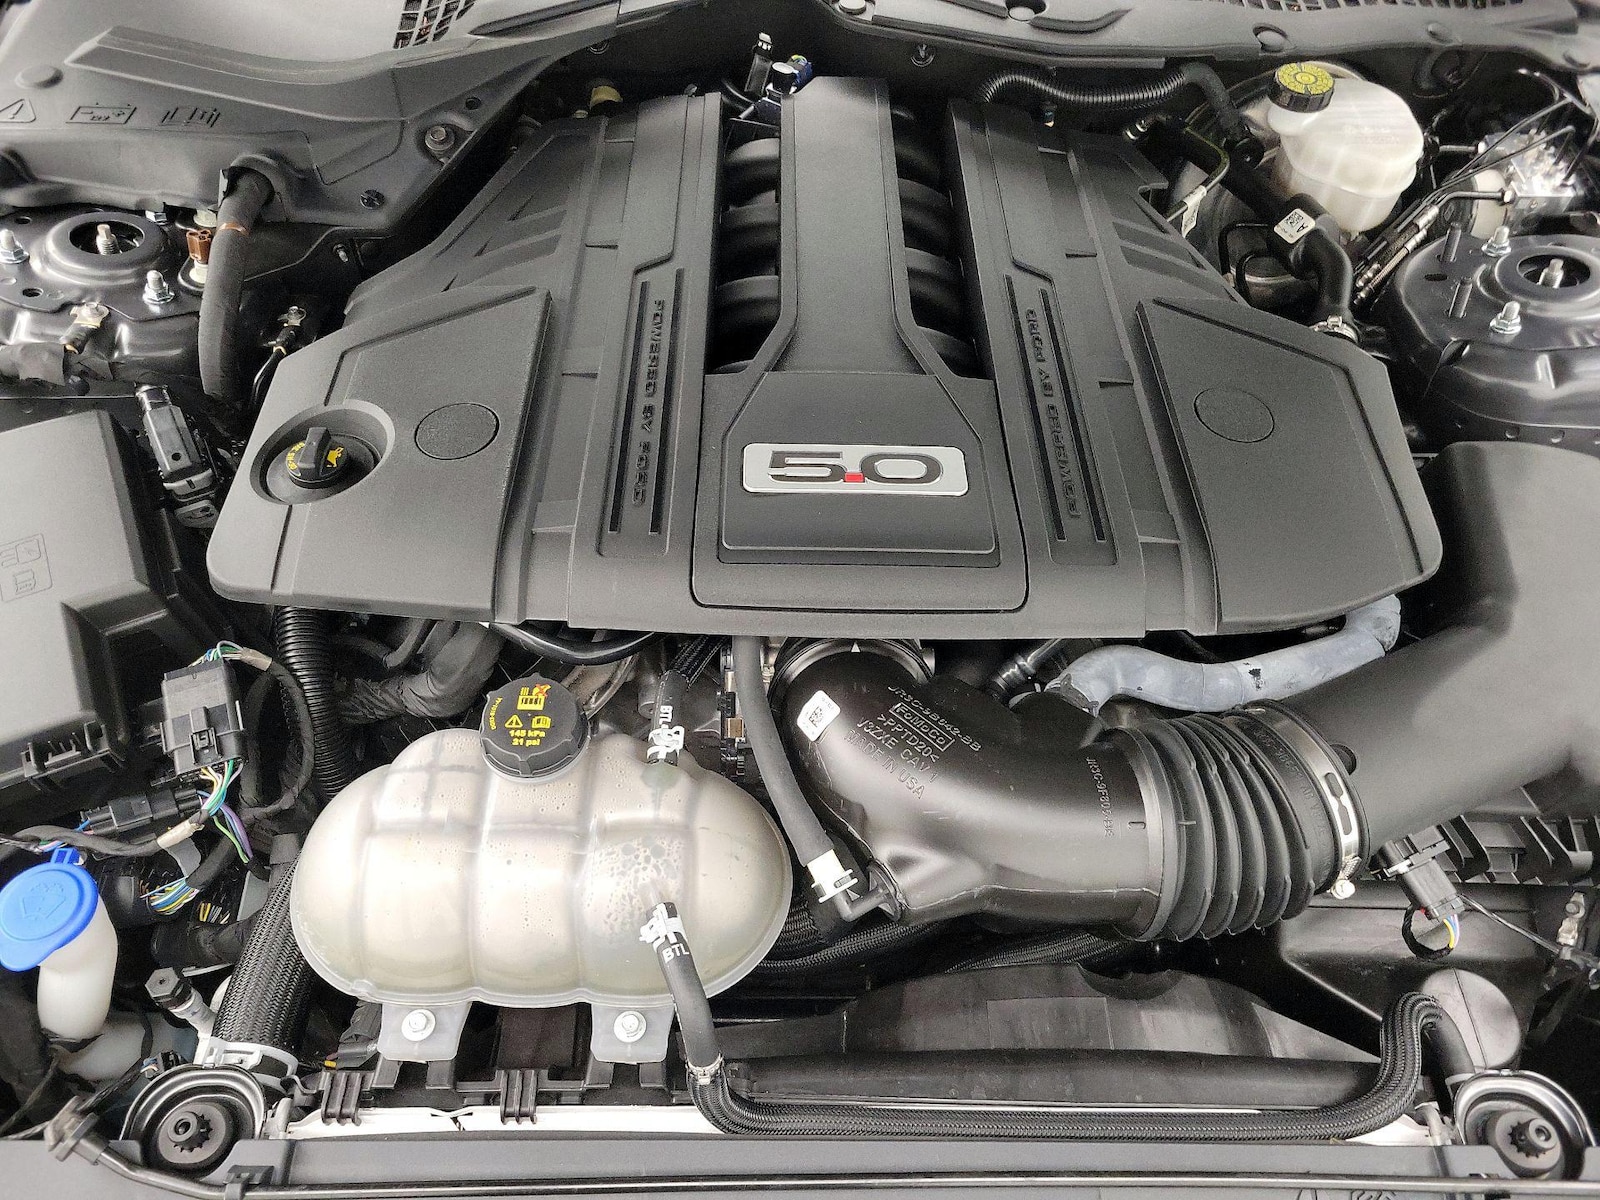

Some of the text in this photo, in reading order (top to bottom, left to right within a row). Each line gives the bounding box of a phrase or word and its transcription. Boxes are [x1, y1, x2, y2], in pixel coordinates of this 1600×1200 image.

[632, 299, 665, 506] POWERED BY FORD
[1026, 308, 1082, 518] POWERED BY FORD
[768, 450, 943, 485] 5.0
[527, 729, 546, 737] kPa
[896, 705, 946, 745] FoMoCo
[843, 729, 925, 799] MADE IN USA
[900, 748, 930, 772] CAV
[662, 943, 690, 964] BTL
